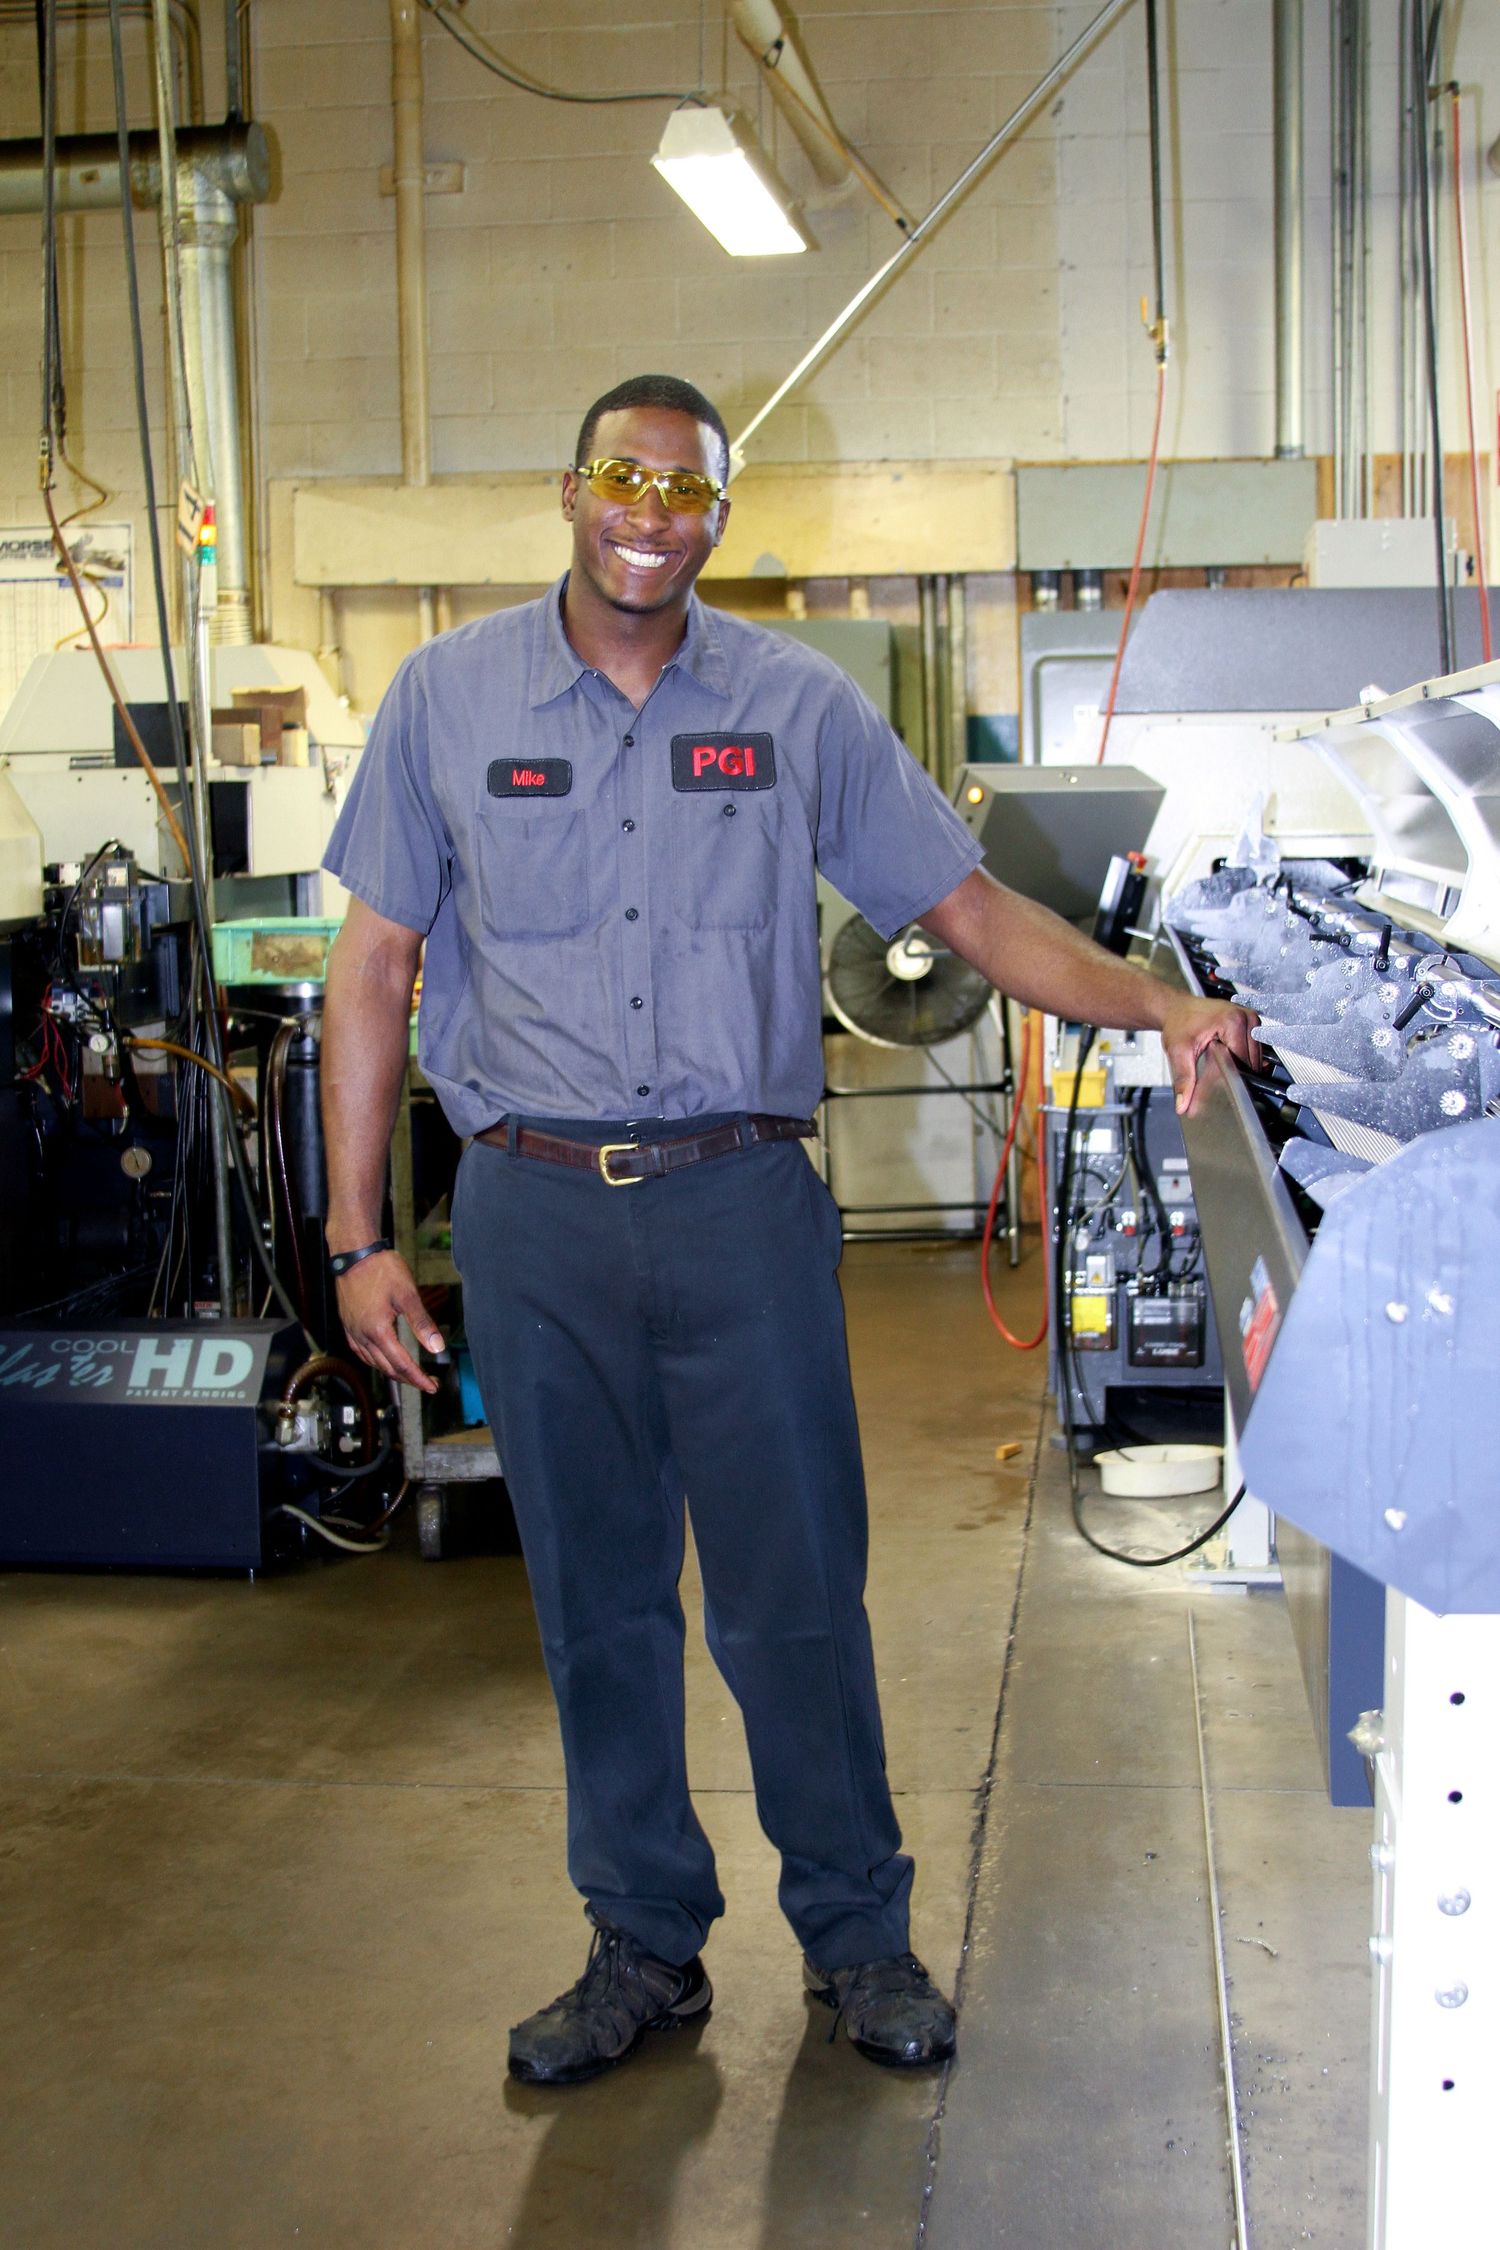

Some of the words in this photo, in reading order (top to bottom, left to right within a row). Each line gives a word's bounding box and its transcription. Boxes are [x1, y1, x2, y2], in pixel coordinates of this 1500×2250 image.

[692, 746, 756, 777] PGI
[512, 768, 545, 787] Mike
[50, 1339, 135, 1354] COOL
[128, 1338, 254, 1389] HD
[126, 1389, 179, 1398] PATENT
[183, 1390, 246, 1399] PENDING
